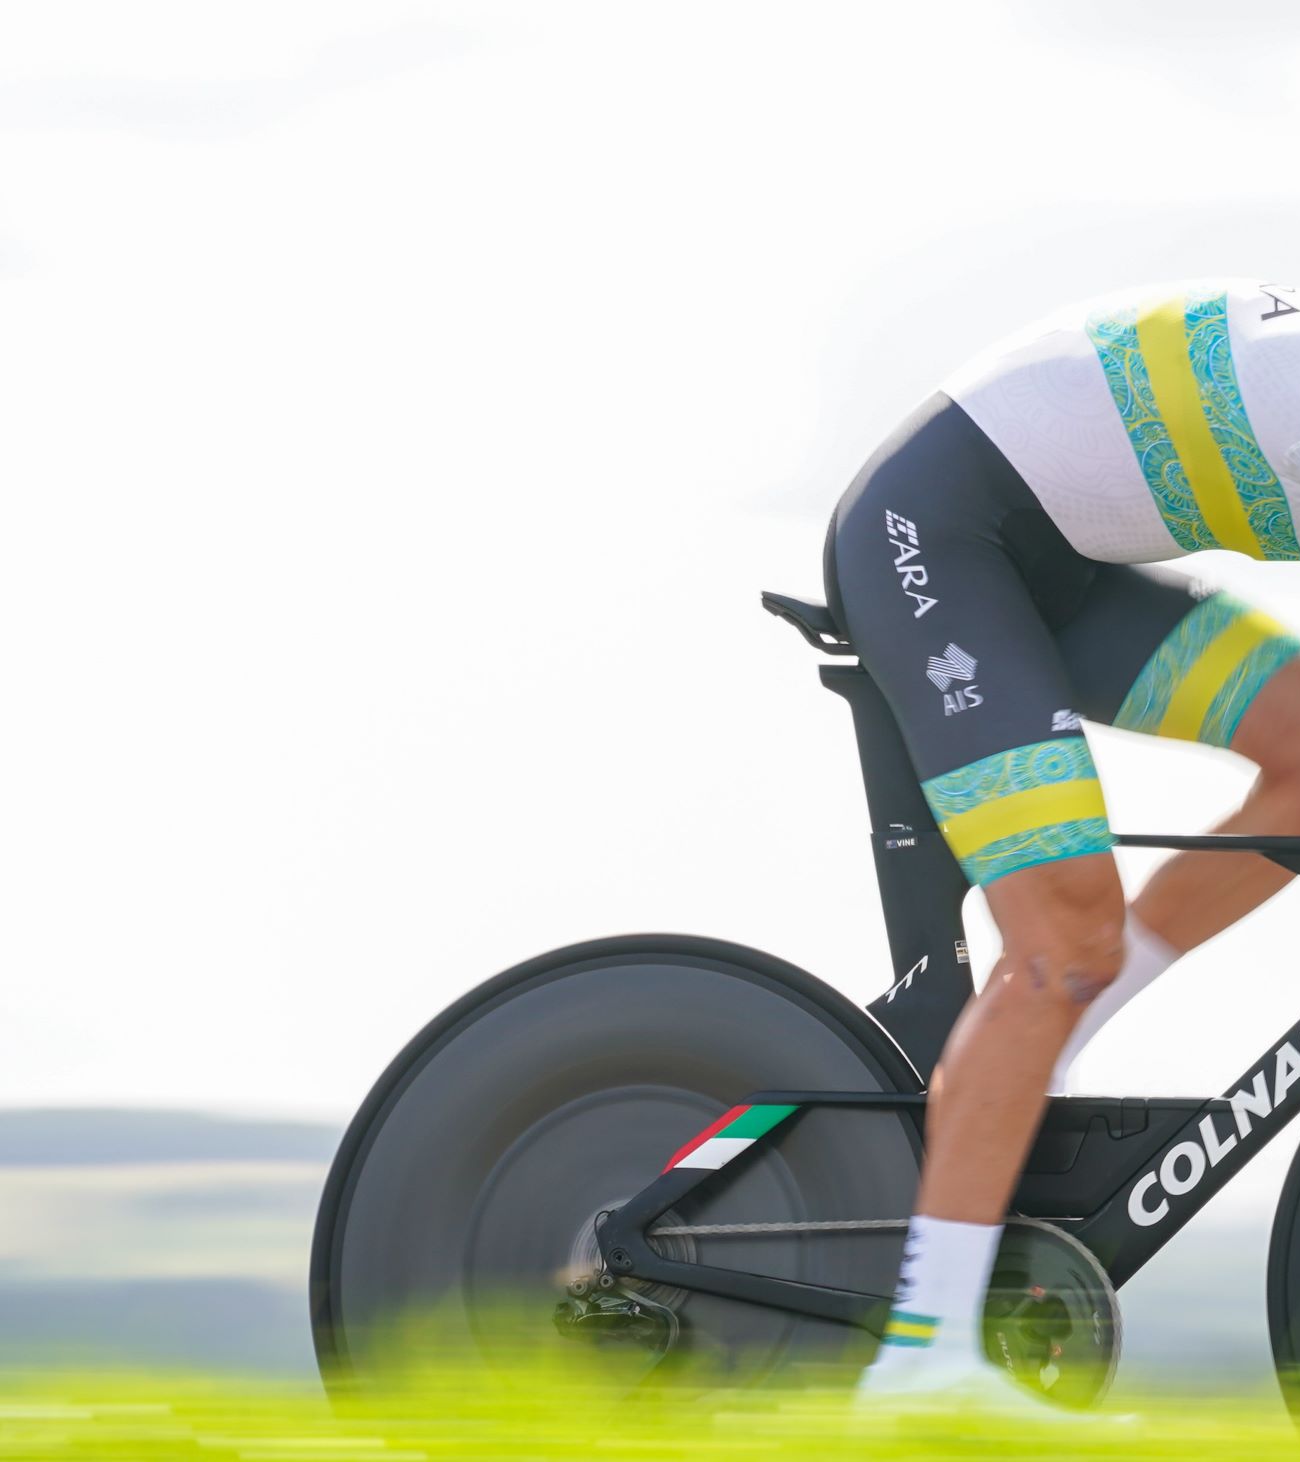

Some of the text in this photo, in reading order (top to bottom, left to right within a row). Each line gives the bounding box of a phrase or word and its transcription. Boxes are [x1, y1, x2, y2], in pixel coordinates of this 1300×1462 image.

[888, 537, 939, 619] ARA
[943, 685, 984, 716] AIS
[896, 838, 915, 847] VINE
